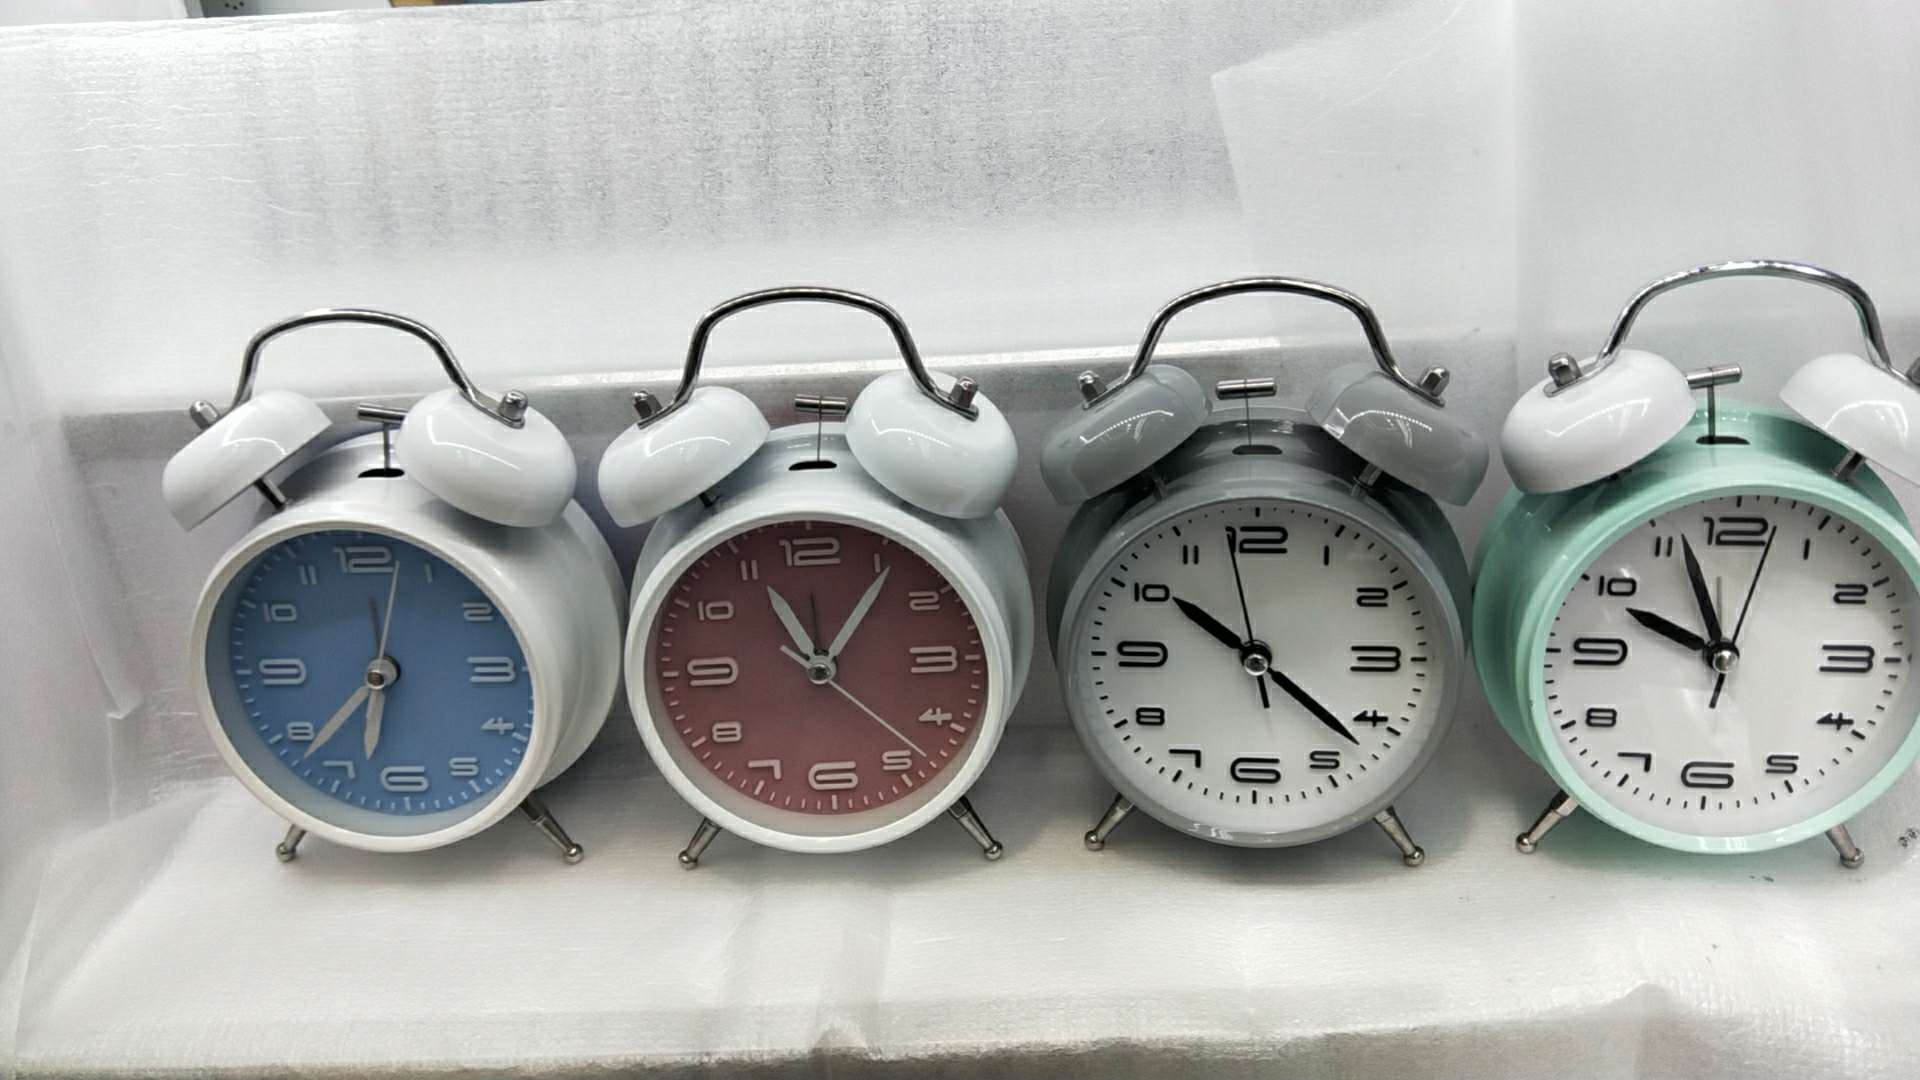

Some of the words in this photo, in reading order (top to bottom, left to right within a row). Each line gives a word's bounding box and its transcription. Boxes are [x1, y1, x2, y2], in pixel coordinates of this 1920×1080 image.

[1226, 526, 1288, 553] 12
[1704, 517, 1768, 546] 12
[779, 537, 841, 567] 12
[1183, 545, 1199, 565] 11
[1324, 546, 1329, 565] 1
[1655, 536, 1673, 557] 11
[1803, 539, 1810, 560] 1
[334, 546, 394, 573] 12
[873, 553, 880, 572] 1
[300, 565, 317, 585] 11
[425, 563, 433, 583] 1
[741, 560, 758, 581] 11
[1134, 583, 1169, 602] 10
[1599, 575, 1637, 596] 10
[1833, 584, 1868, 604] 2
[909, 591, 940, 611] 2
[1357, 587, 1388, 607] 2
[263, 603, 297, 622] 10
[462, 602, 493, 621] 2
[698, 601, 734, 621] 10
[910, 646, 958, 673] 3
[1117, 641, 1168, 667] 9
[1350, 646, 1401, 672] 3
[1573, 638, 1628, 665] 9
[1819, 645, 1875, 673] 3
[259, 659, 306, 685] 9
[467, 656, 515, 683] 3
[687, 657, 739, 686] 9
[481, 717, 514, 735] 4
[918, 708, 952, 725] 4
[1136, 707, 1165, 726] 8
[1353, 710, 1388, 727] 4
[1586, 708, 1617, 727] 8
[1817, 713, 1854, 730] 4
[287, 721, 314, 740] 8
[712, 721, 742, 742] 8
[449, 757, 479, 776] 5
[882, 750, 912, 771] 5
[1169, 748, 1201, 768] 7
[1310, 751, 1340, 769] 5
[1618, 753, 1651, 772] 7
[1765, 755, 1799, 774] 5
[323, 760, 355, 779] 7
[380, 766, 429, 792] 6
[748, 760, 782, 779] 7
[808, 761, 858, 790] 6
[1231, 758, 1281, 783] 6
[1681, 762, 1734, 788] 6
